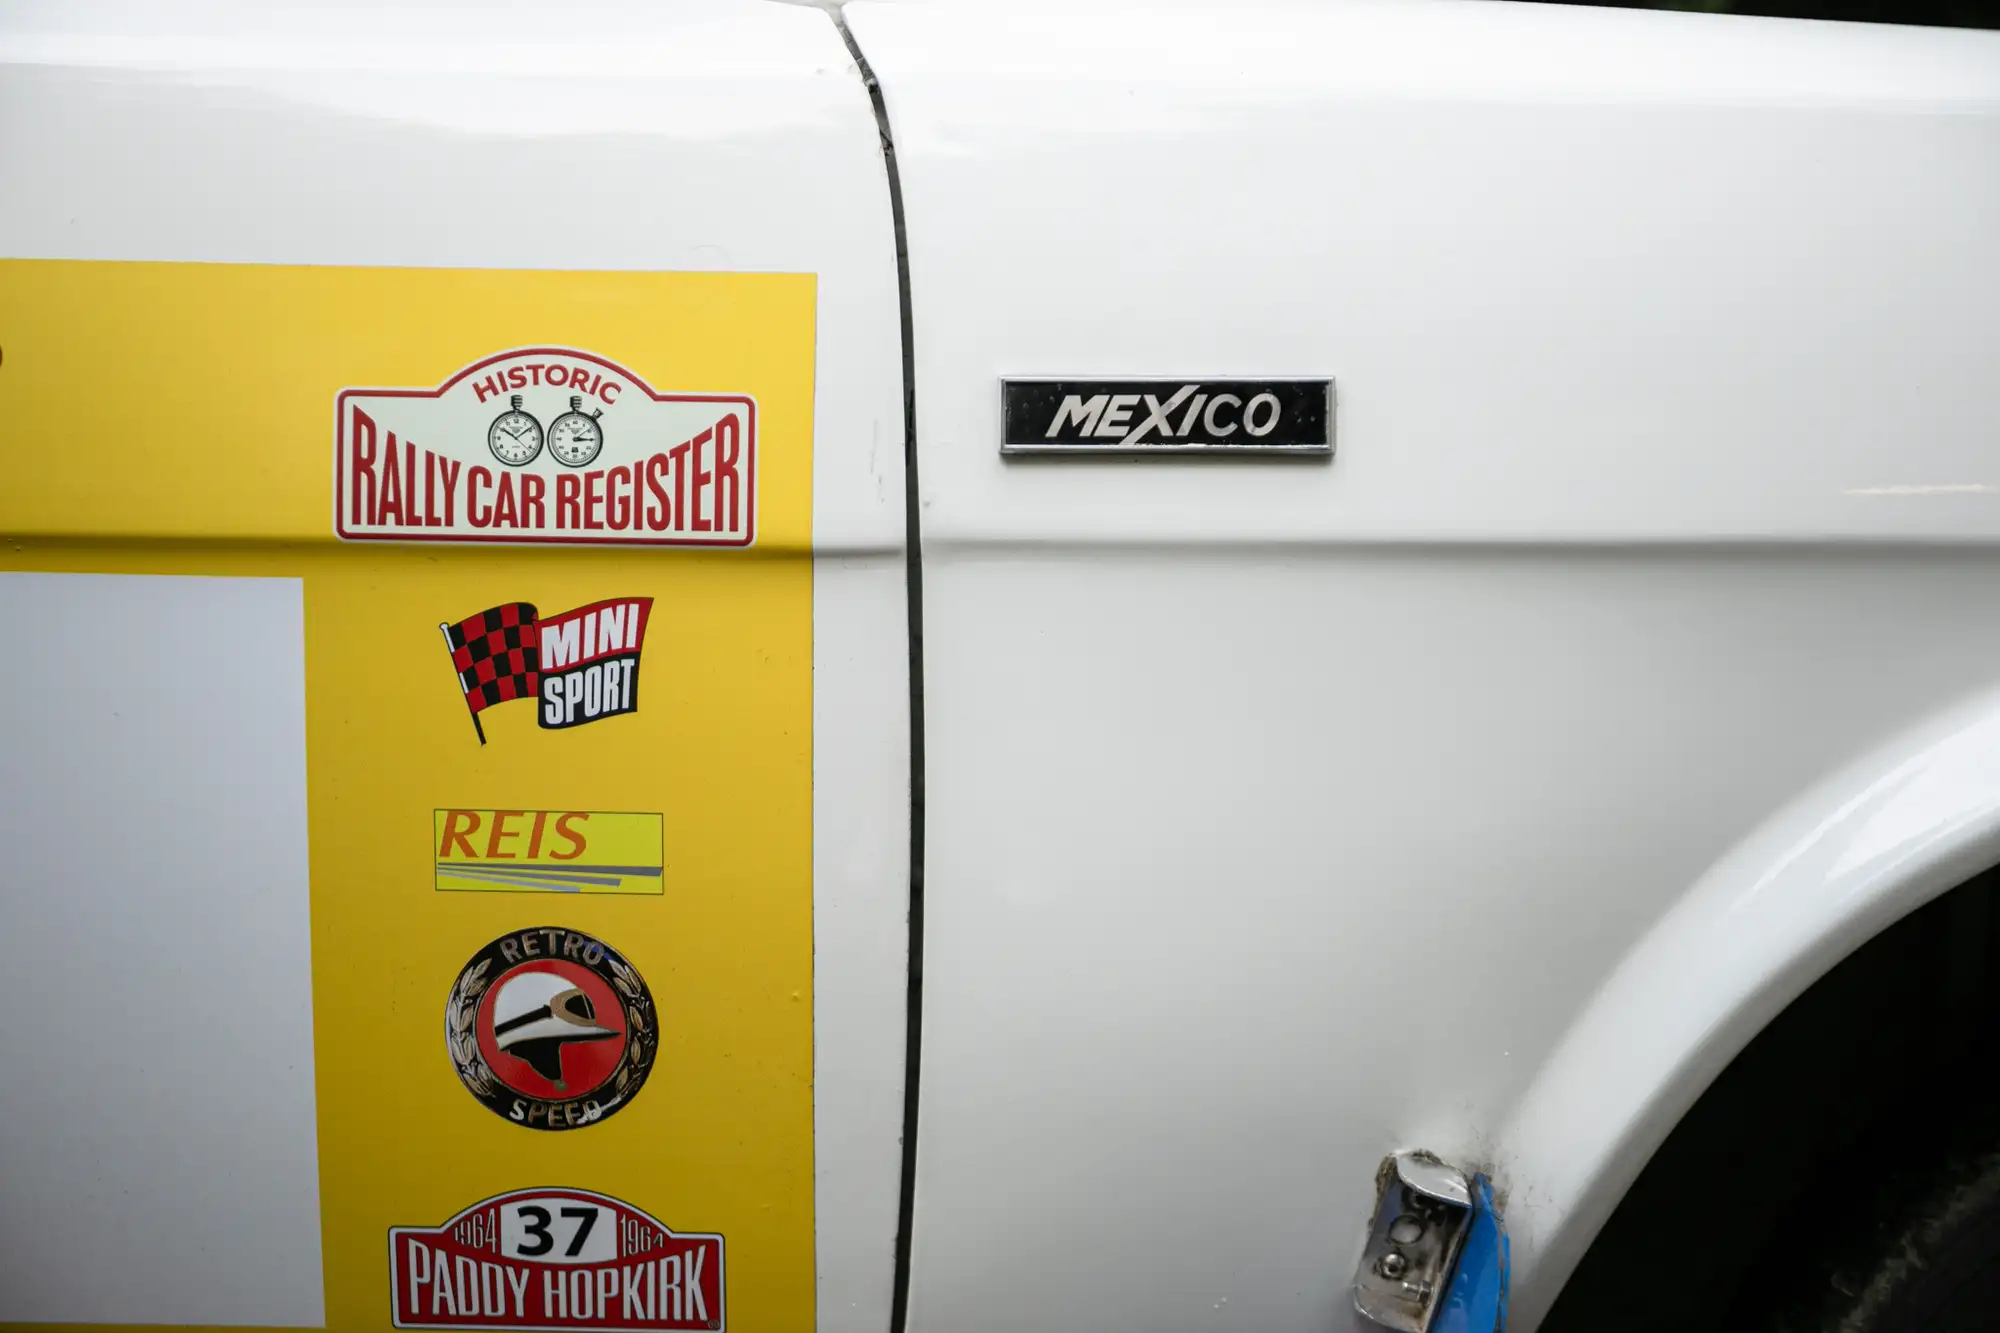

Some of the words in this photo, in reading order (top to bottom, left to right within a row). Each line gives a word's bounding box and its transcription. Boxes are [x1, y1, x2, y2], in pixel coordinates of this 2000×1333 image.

[471, 363, 622, 405] HISTORIC
[1045, 384, 1282, 446] MEXICO
[351, 403, 462, 528] RALLY
[467, 464, 547, 530] CAR
[556, 412, 740, 533] REGISTER
[541, 603, 640, 670] MINI
[543, 658, 635, 725] SPORT
[438, 811, 590, 860] REIS
[500, 928, 605, 966] RETRO
[508, 1099, 602, 1128] SPEED
[453, 1208, 497, 1254] 1964
[516, 1205, 599, 1257] 37
[620, 1213, 664, 1258] 1964
[408, 1237, 530, 1319] PADDY
[543, 1244, 708, 1321] HOPKIRK
